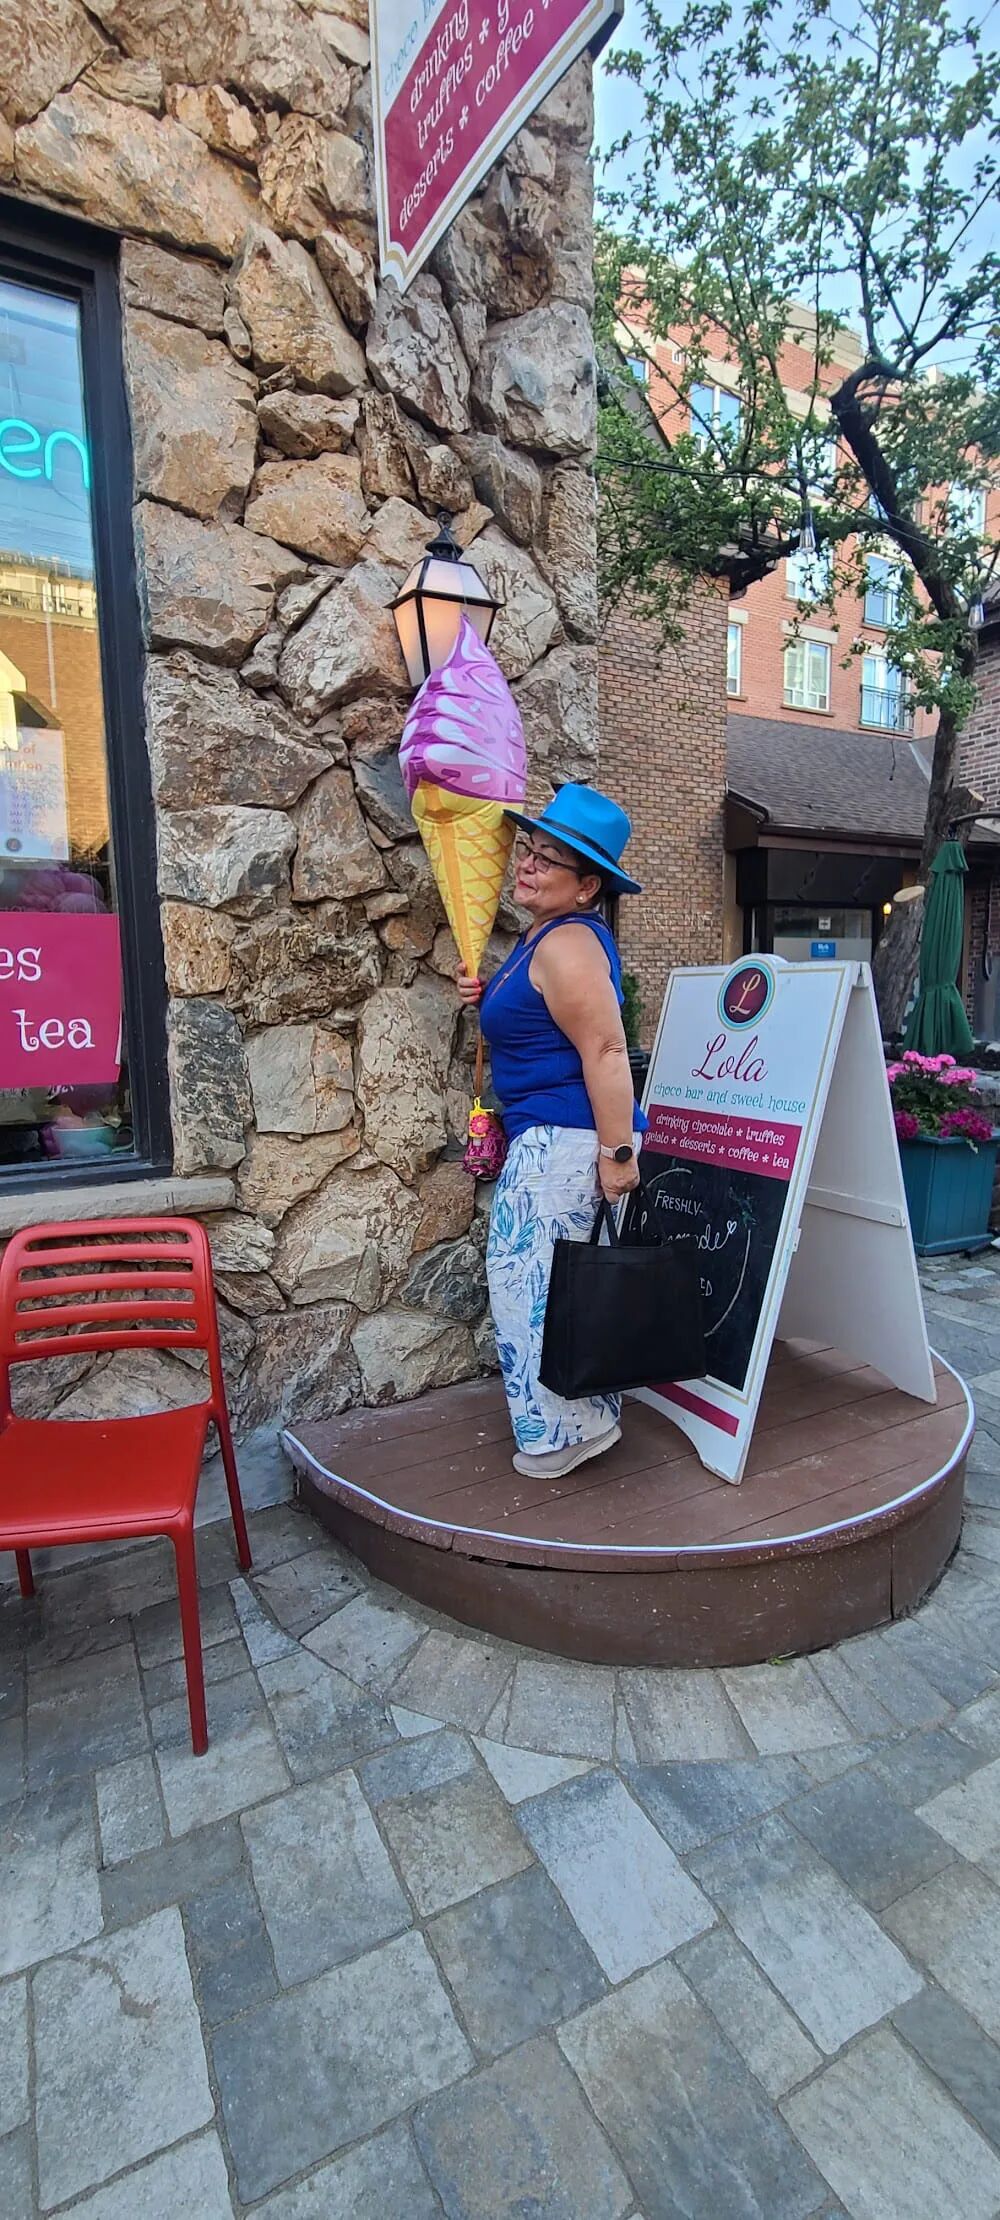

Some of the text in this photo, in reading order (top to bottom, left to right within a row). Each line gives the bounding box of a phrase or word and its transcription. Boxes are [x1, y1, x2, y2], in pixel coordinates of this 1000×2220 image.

[411, 0, 469, 112] drinking
[417, 42, 474, 149] truffles
[400, 9, 535, 231] desserts coffee
[729, 973, 761, 1015] L
[12, 1008, 95, 1052] tea
[691, 1033, 769, 1082] Lola
[654, 1083, 806, 1113] choco bar and sweet house
[644, 1130, 789, 1168] gelato desserts coffee tea
[656, 1113, 785, 1146] drinking chocolate truffles
